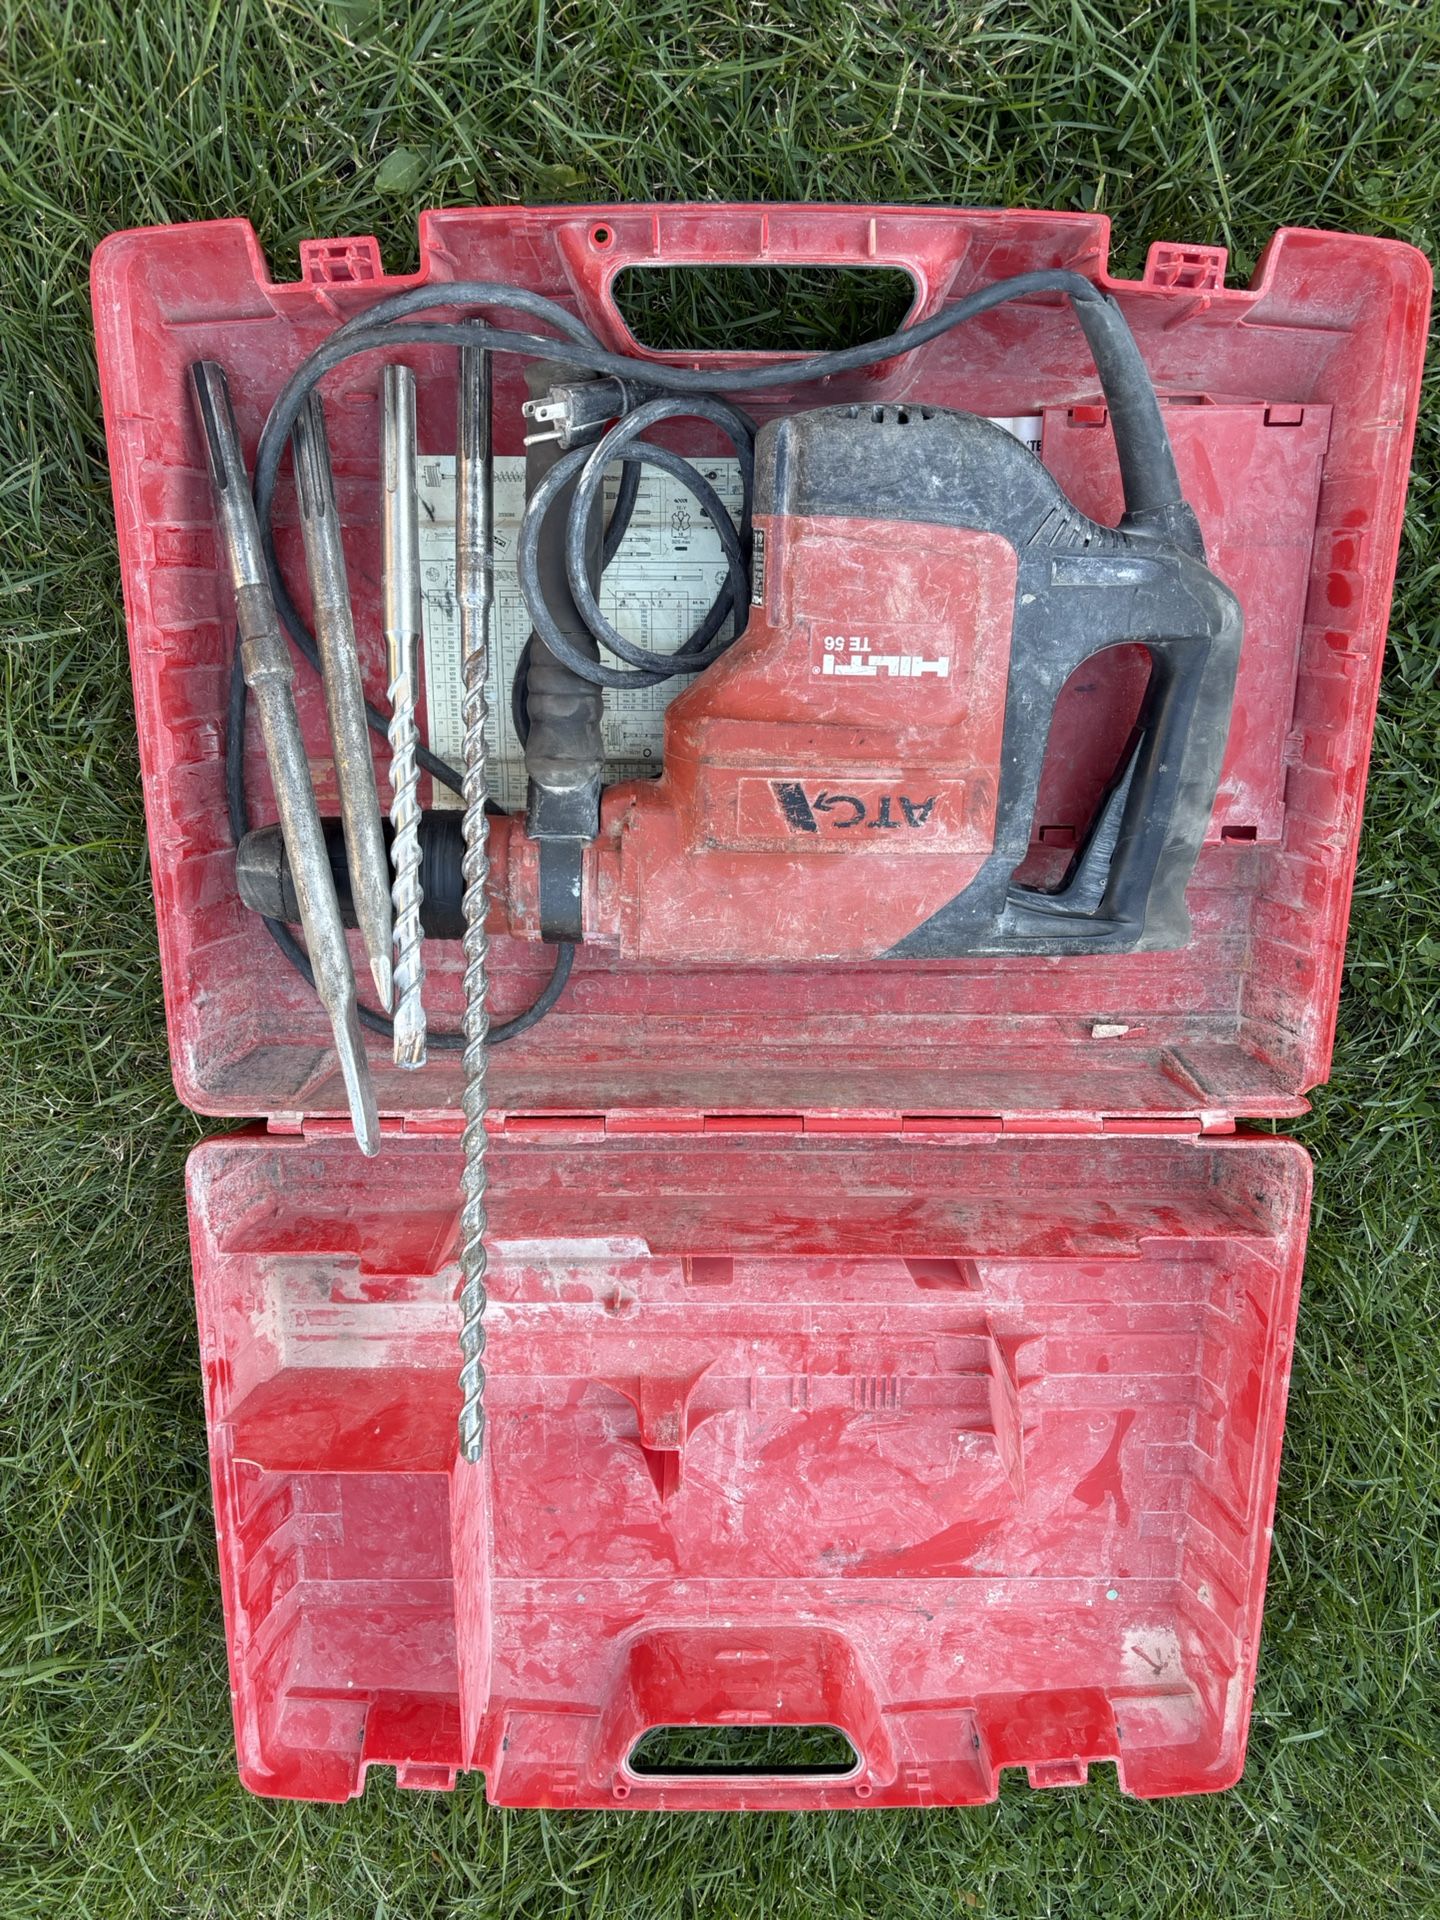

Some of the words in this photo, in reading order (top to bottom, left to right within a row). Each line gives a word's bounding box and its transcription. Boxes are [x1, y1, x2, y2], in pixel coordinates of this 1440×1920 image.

[824, 636, 845, 650] 56
[849, 636, 871, 652] TE
[823, 654, 949, 677] HILTI
